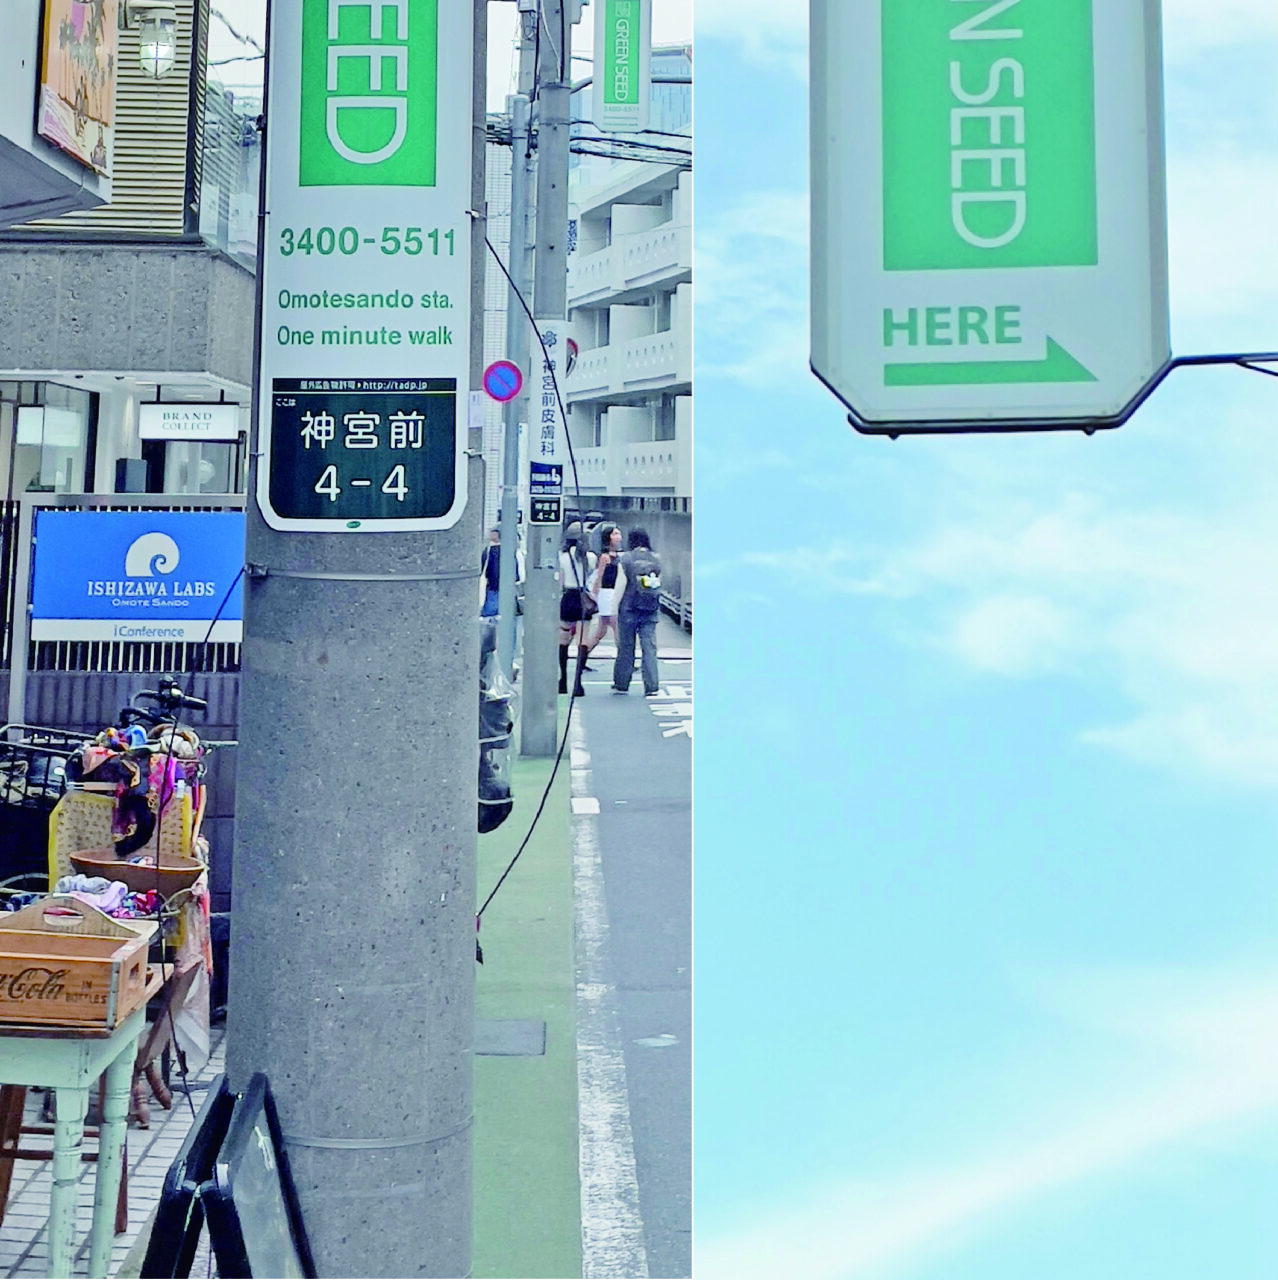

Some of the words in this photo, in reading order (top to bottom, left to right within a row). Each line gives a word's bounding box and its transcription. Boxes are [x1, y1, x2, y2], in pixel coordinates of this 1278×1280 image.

[615, 18, 630, 64] GREEN
[614, 65, 629, 101] SEED
[949, 56, 1027, 249] SEED
[280, 227, 455, 256] 3400-5511
[278, 289, 414, 309] Omotesando
[420, 290, 454, 309] sta.
[277, 325, 315, 345] One
[321, 325, 402, 345] minute
[408, 326, 453, 345] walk
[882, 305, 1022, 346] HERE
[162, 411, 213, 421] BRAND
[162, 422, 212, 431] COLLECT
[300, 410, 425, 450] 神宮前
[314, 464, 409, 502] 4-4
[87, 581, 168, 597] ISHIZAWA
[173, 582, 215, 597] LABS
[65, 992, 107, 1004] BOTTLES
